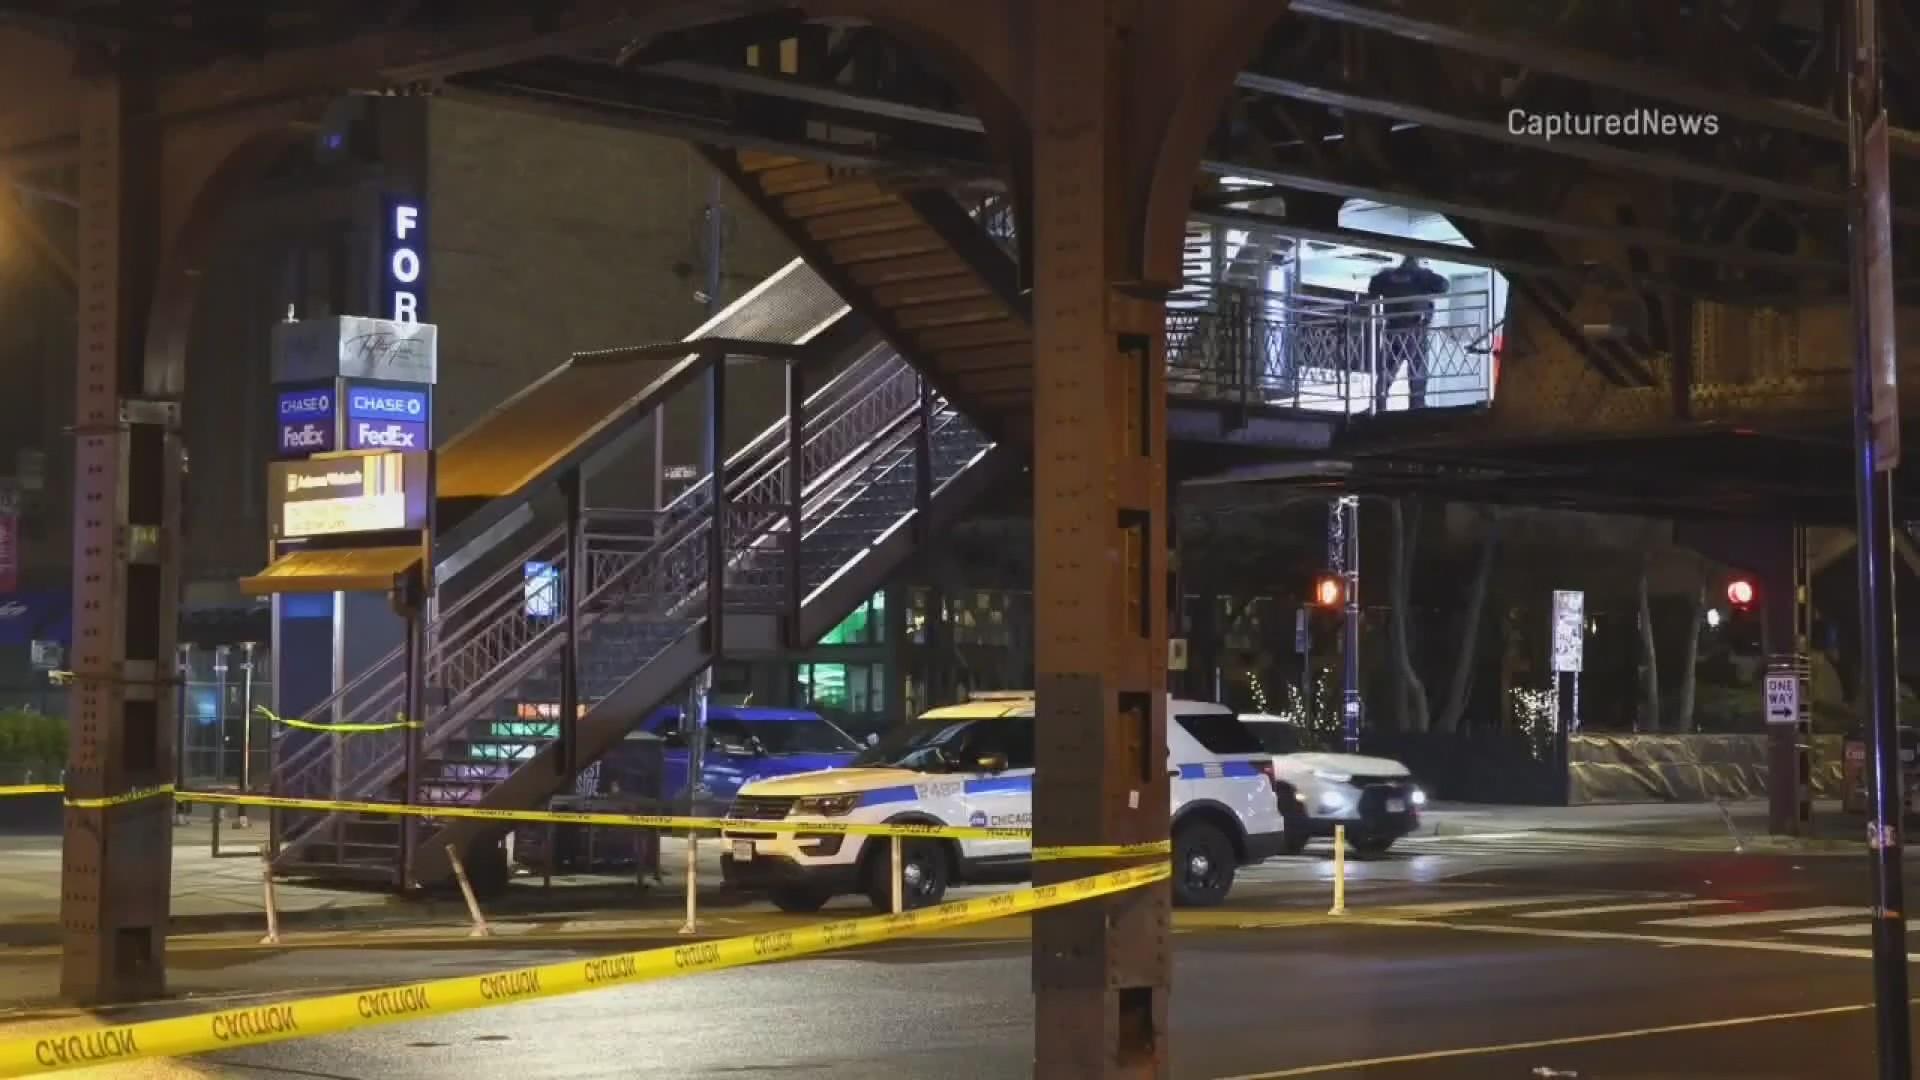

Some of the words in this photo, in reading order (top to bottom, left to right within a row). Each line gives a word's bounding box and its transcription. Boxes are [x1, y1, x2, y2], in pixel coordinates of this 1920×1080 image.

[281, 397, 319, 414] CHASE
[354, 396, 405, 410] CHASE
[283, 423, 324, 447] FedEx
[359, 422, 415, 447] FedEx
[1768, 680, 1793, 690] ONE
[1768, 693, 1793, 704] WAY
